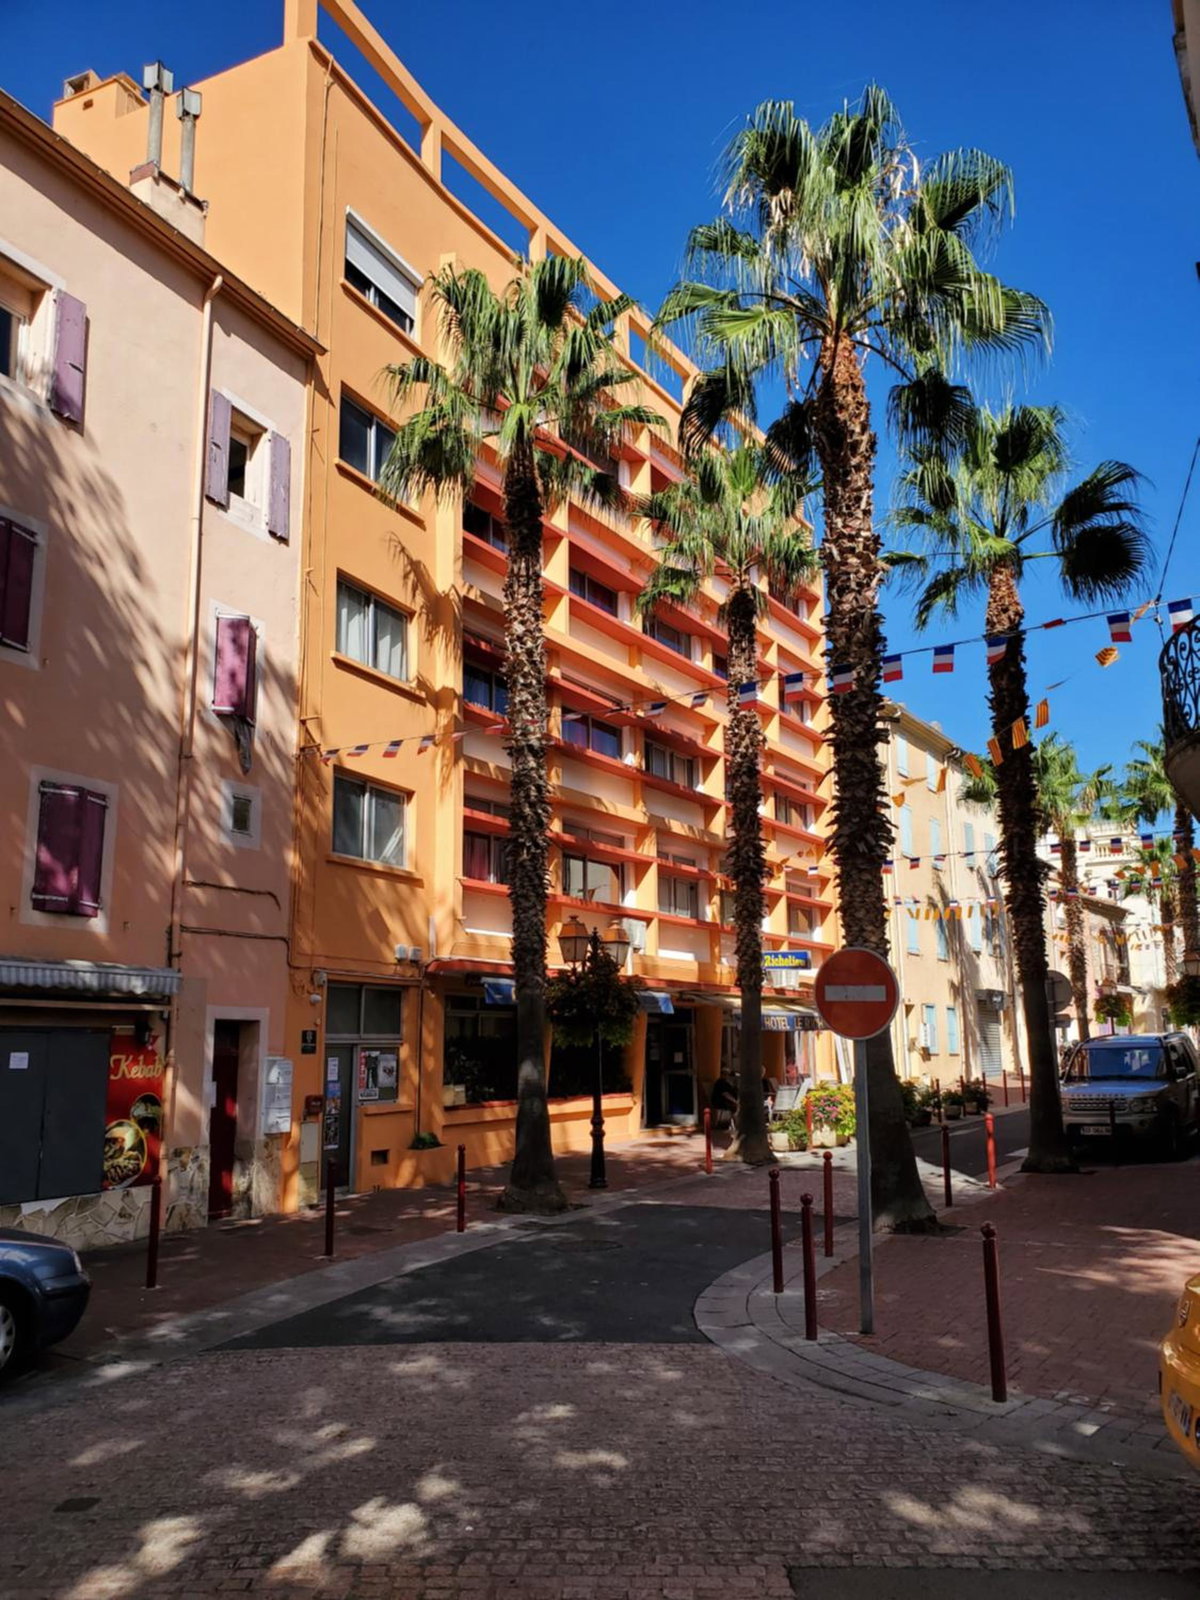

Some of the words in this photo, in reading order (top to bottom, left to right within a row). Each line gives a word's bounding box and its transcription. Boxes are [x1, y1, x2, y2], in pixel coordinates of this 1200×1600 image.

[764, 1016, 790, 1030] HOTEL
[794, 1016, 802, 1029] LE
[109, 1054, 162, 1080] Kebab
